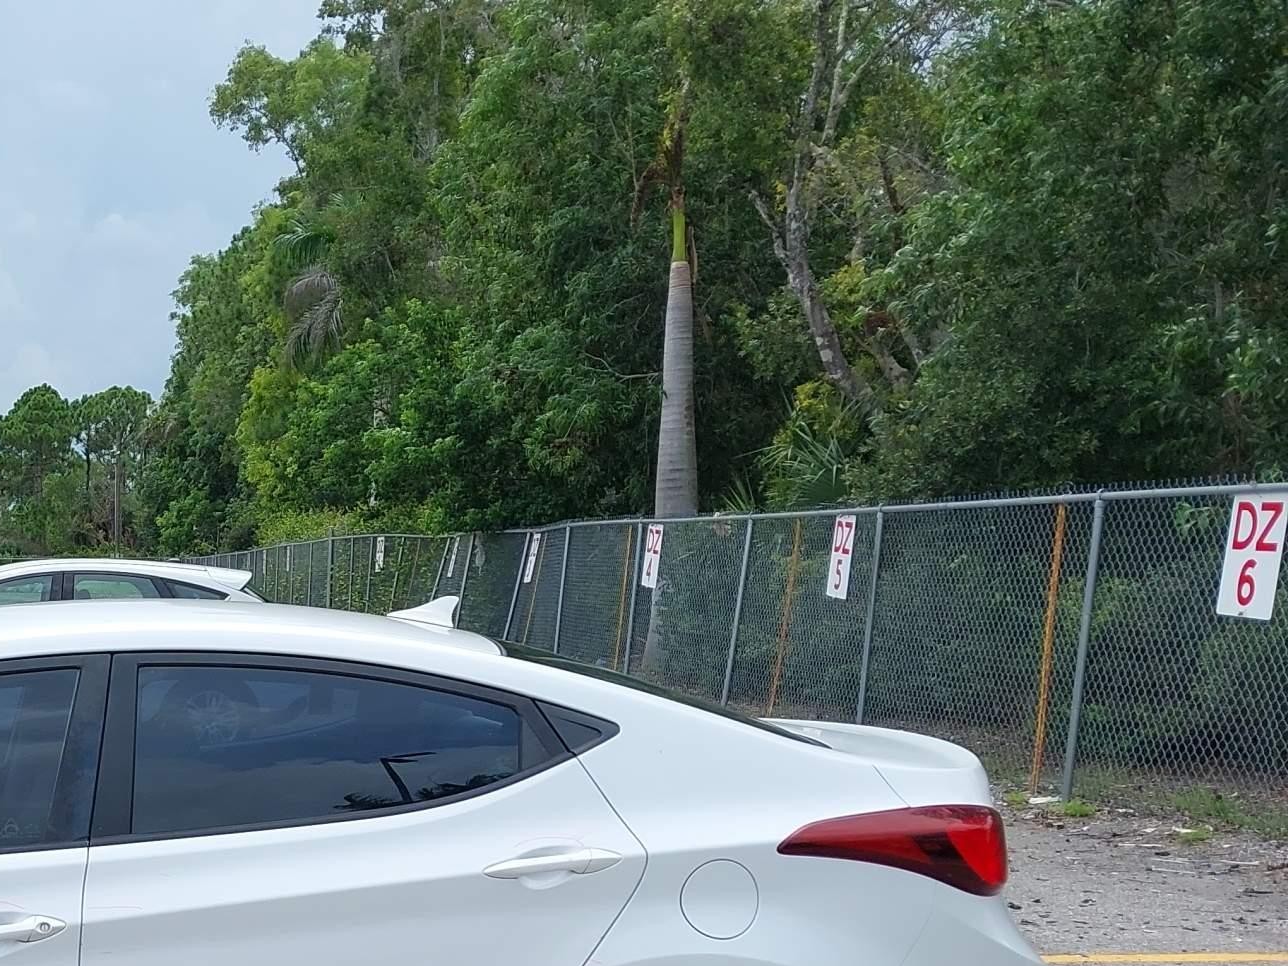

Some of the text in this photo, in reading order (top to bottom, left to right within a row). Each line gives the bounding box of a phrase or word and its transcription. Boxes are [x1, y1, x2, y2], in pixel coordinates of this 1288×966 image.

[647, 528, 661, 555] DZ
[834, 520, 853, 555] DZ
[1232, 501, 1284, 552] DZ
[834, 559, 843, 590] 5
[1236, 559, 1258, 606] 6
